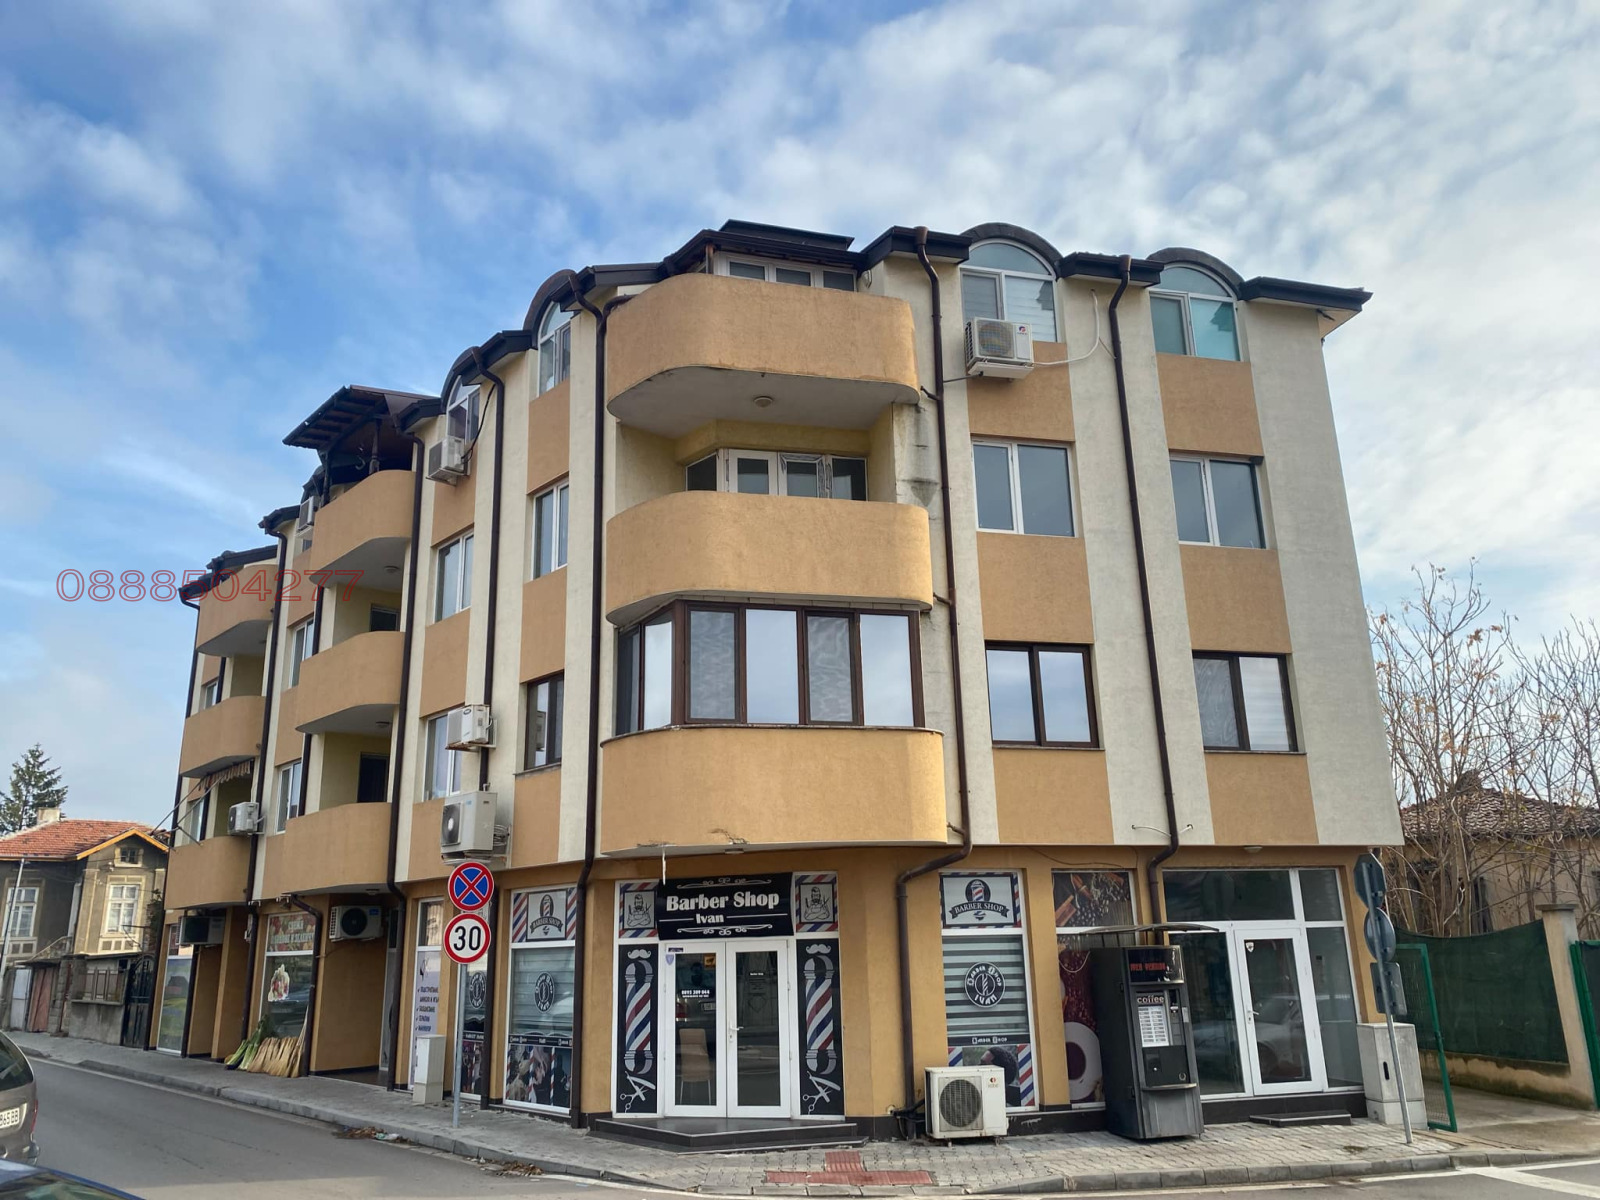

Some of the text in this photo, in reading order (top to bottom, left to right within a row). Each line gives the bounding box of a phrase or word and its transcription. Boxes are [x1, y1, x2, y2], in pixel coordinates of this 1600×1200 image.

[666, 891, 780, 912] Barber Shop
[954, 902, 1004, 914] BARBER SHOP
[696, 913, 724, 924] Ivan
[453, 925, 481, 951] 30
[1137, 994, 1165, 1004] coffee
